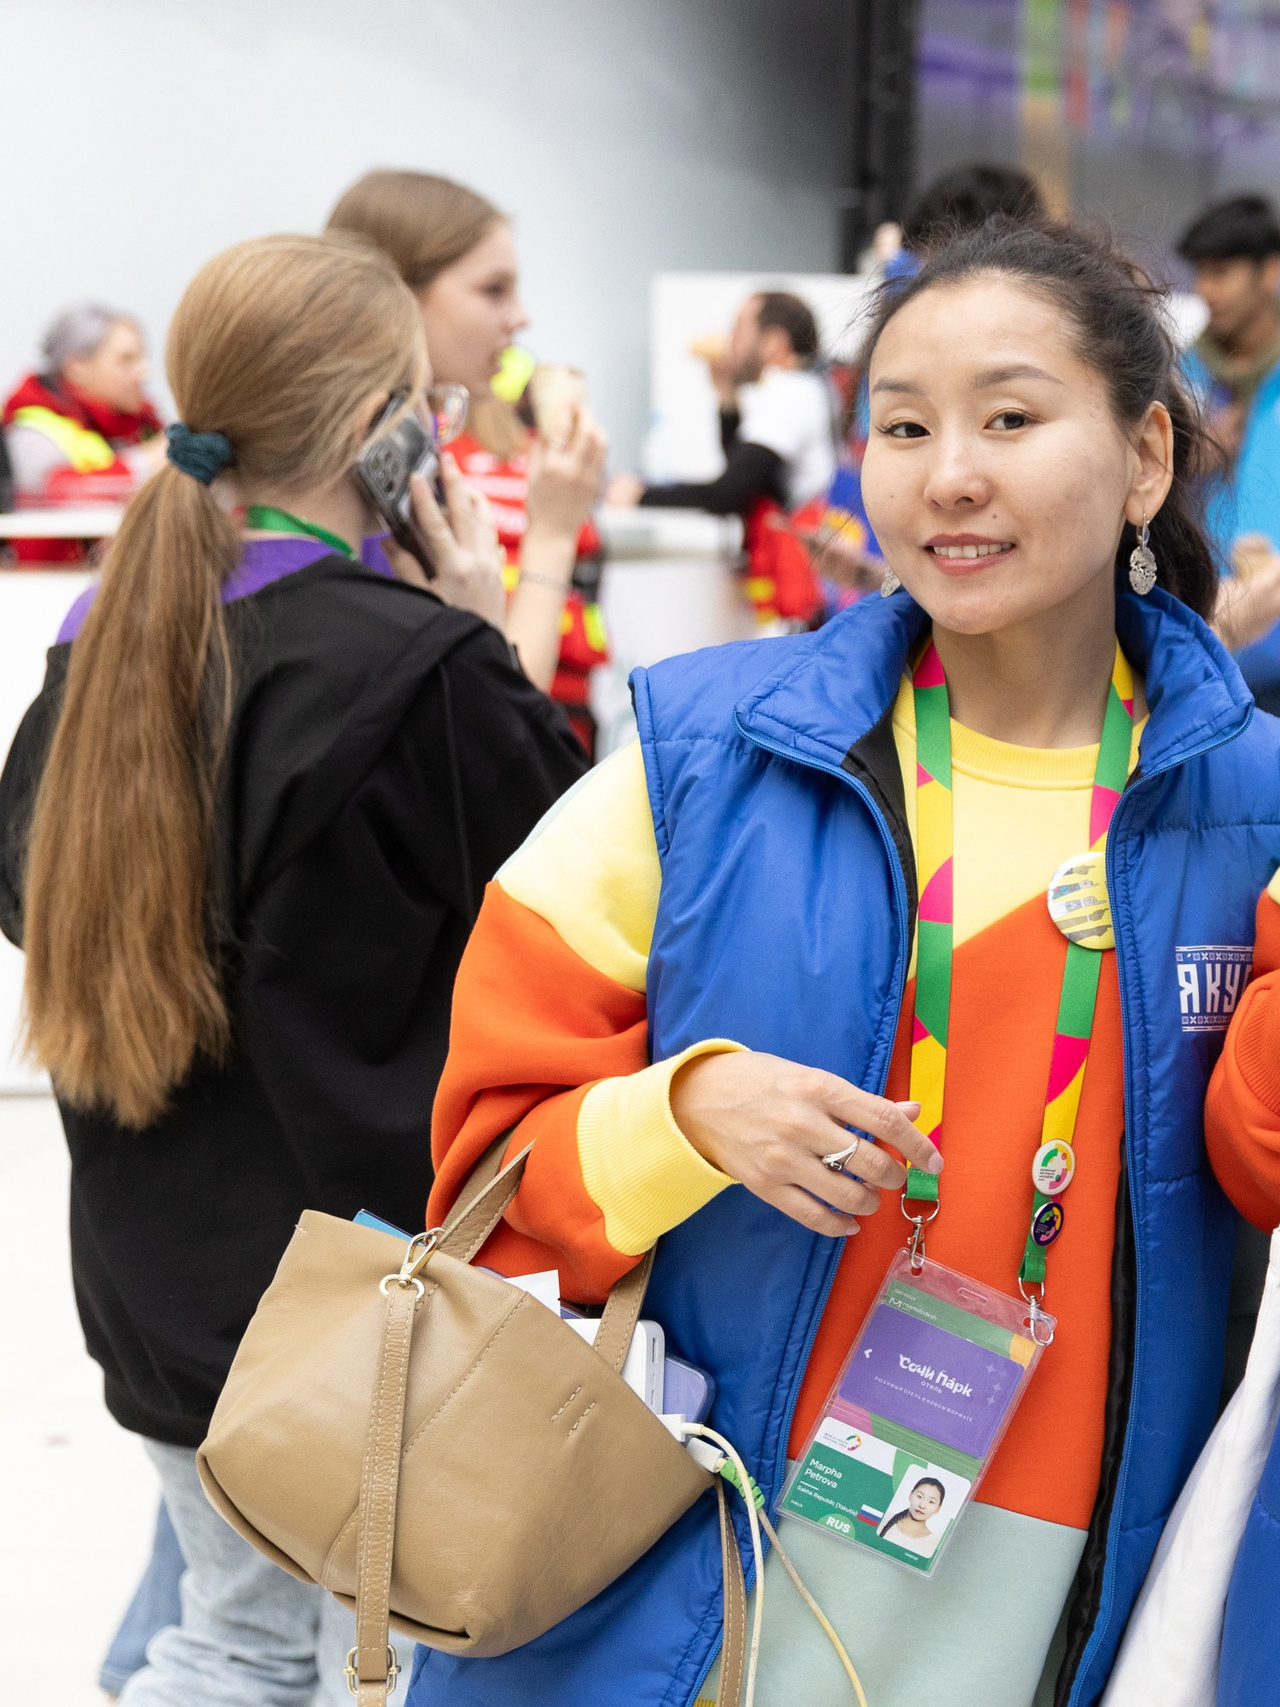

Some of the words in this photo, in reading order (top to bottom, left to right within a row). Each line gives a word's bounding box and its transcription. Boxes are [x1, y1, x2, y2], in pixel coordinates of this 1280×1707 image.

[899, 1353, 935, 1380] Сочи
[935, 1369, 973, 1397] Парк
[804, 1468, 838, 1489] Petrova
[809, 1458, 843, 1479] Marpha
[826, 1516, 851, 1533] RUS
